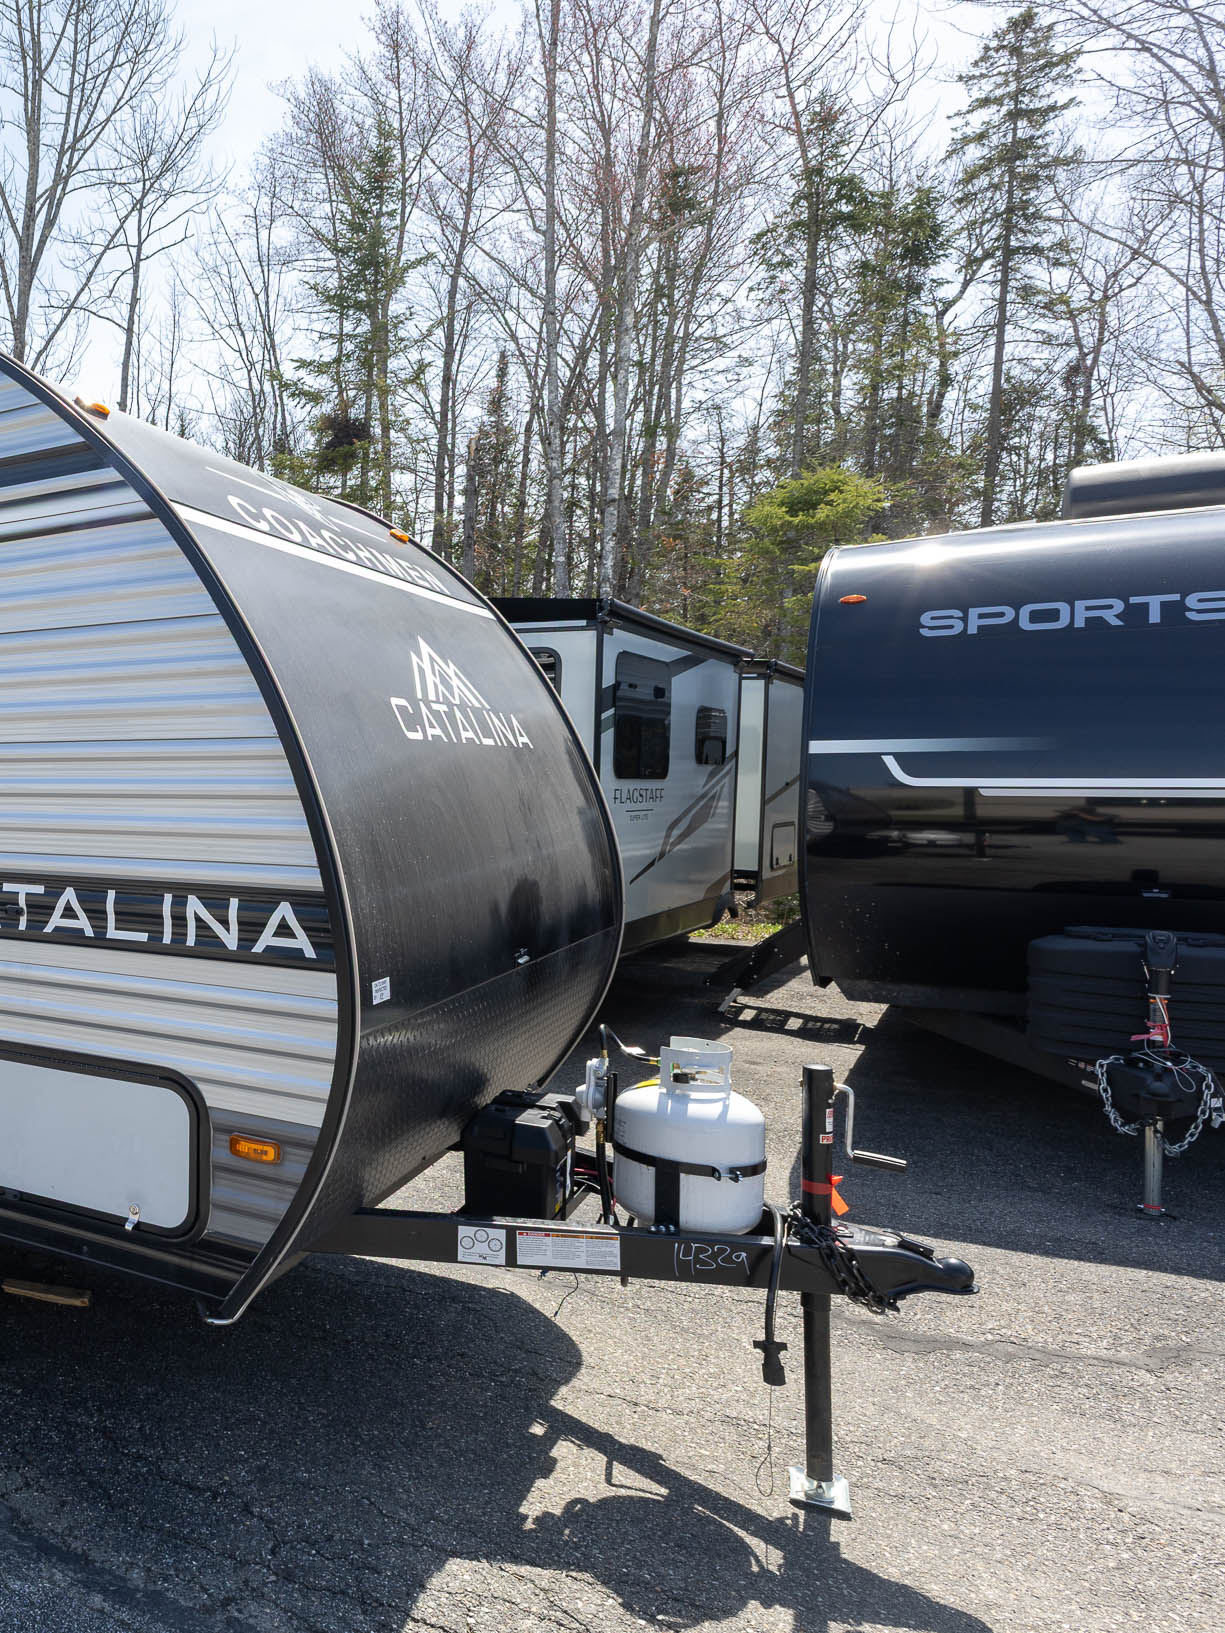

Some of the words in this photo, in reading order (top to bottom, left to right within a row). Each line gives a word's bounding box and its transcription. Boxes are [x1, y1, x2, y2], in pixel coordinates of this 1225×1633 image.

[227, 495, 450, 593] COACHMEN
[390, 697, 534, 749] CATALINA
[613, 787, 664, 804] FLAGSTAFF
[674, 1242, 751, 1277] 14329
